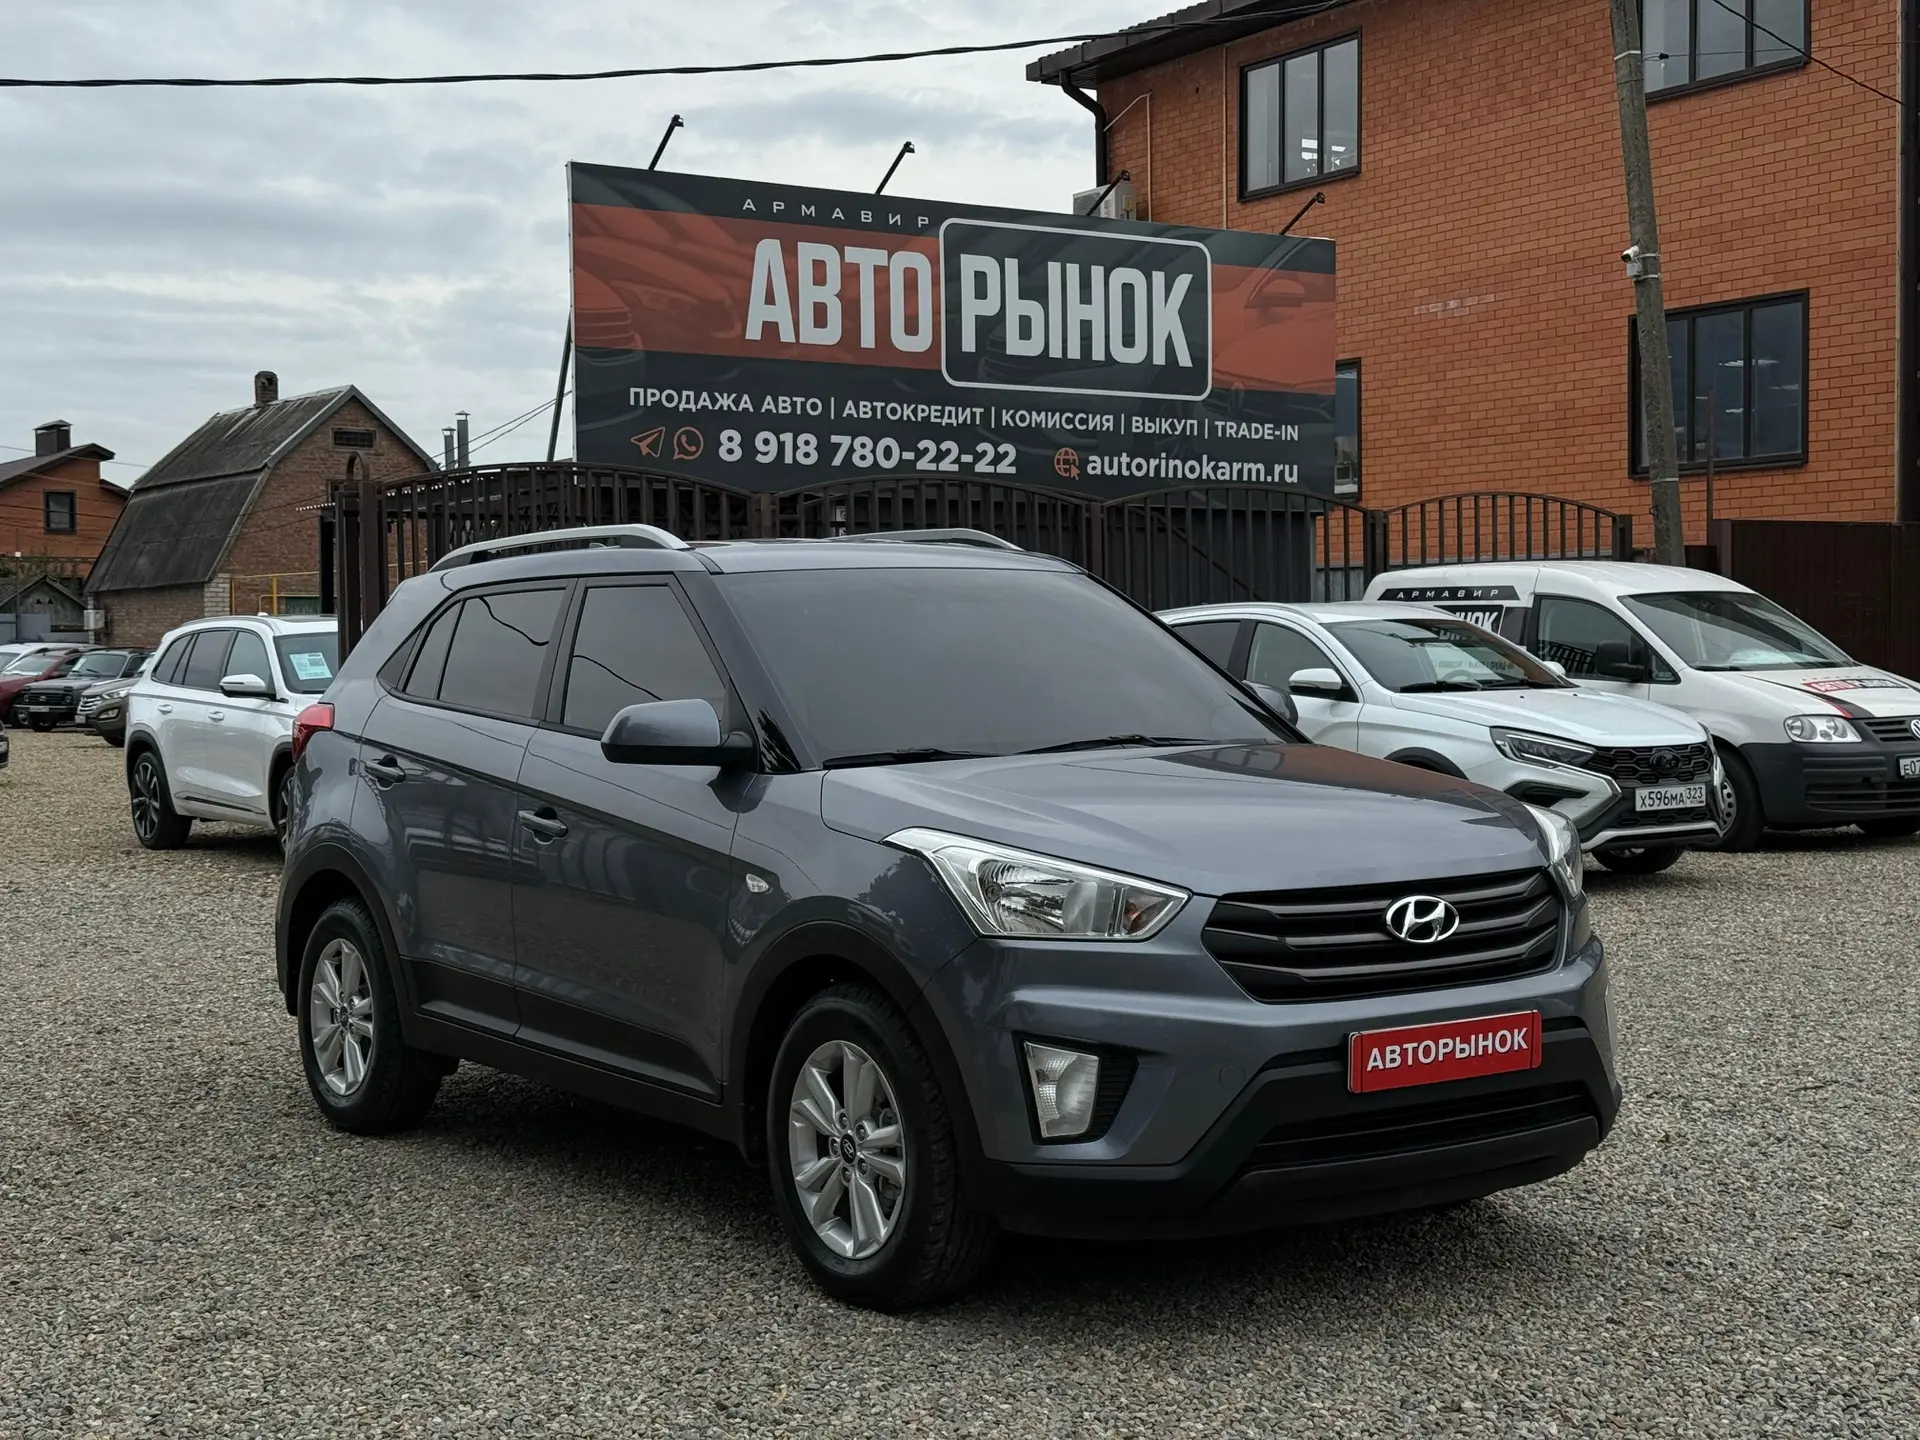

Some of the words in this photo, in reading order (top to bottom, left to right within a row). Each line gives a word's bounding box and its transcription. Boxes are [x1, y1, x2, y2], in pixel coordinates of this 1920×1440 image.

[742, 198, 929, 228] АРМАВИР
[745, 238, 933, 353] АВТО
[960, 253, 1194, 368] РЫНОК
[629, 387, 754, 413] ПРОДАЖА
[760, 394, 823, 416] АВТО
[842, 399, 984, 426] АВТОКРЕДИТ
[1001, 409, 1114, 432] КОМИССИЯ
[1131, 415, 1198, 437] ВЫКУП
[1214, 420, 1299, 441] TRADE-IN
[718, 428, 743, 462] 8
[754, 430, 819, 466] 918
[830, 434, 1017, 474] 780-22-22
[1086, 451, 1299, 484] autorinokarm.ru
[1396, 589, 1499, 600] АРМАВИР
[1640, 789, 1685, 809] Х596МА
[1686, 786, 1703, 800] 323
[1366, 1027, 1528, 1072] АВТОРЫНОК
